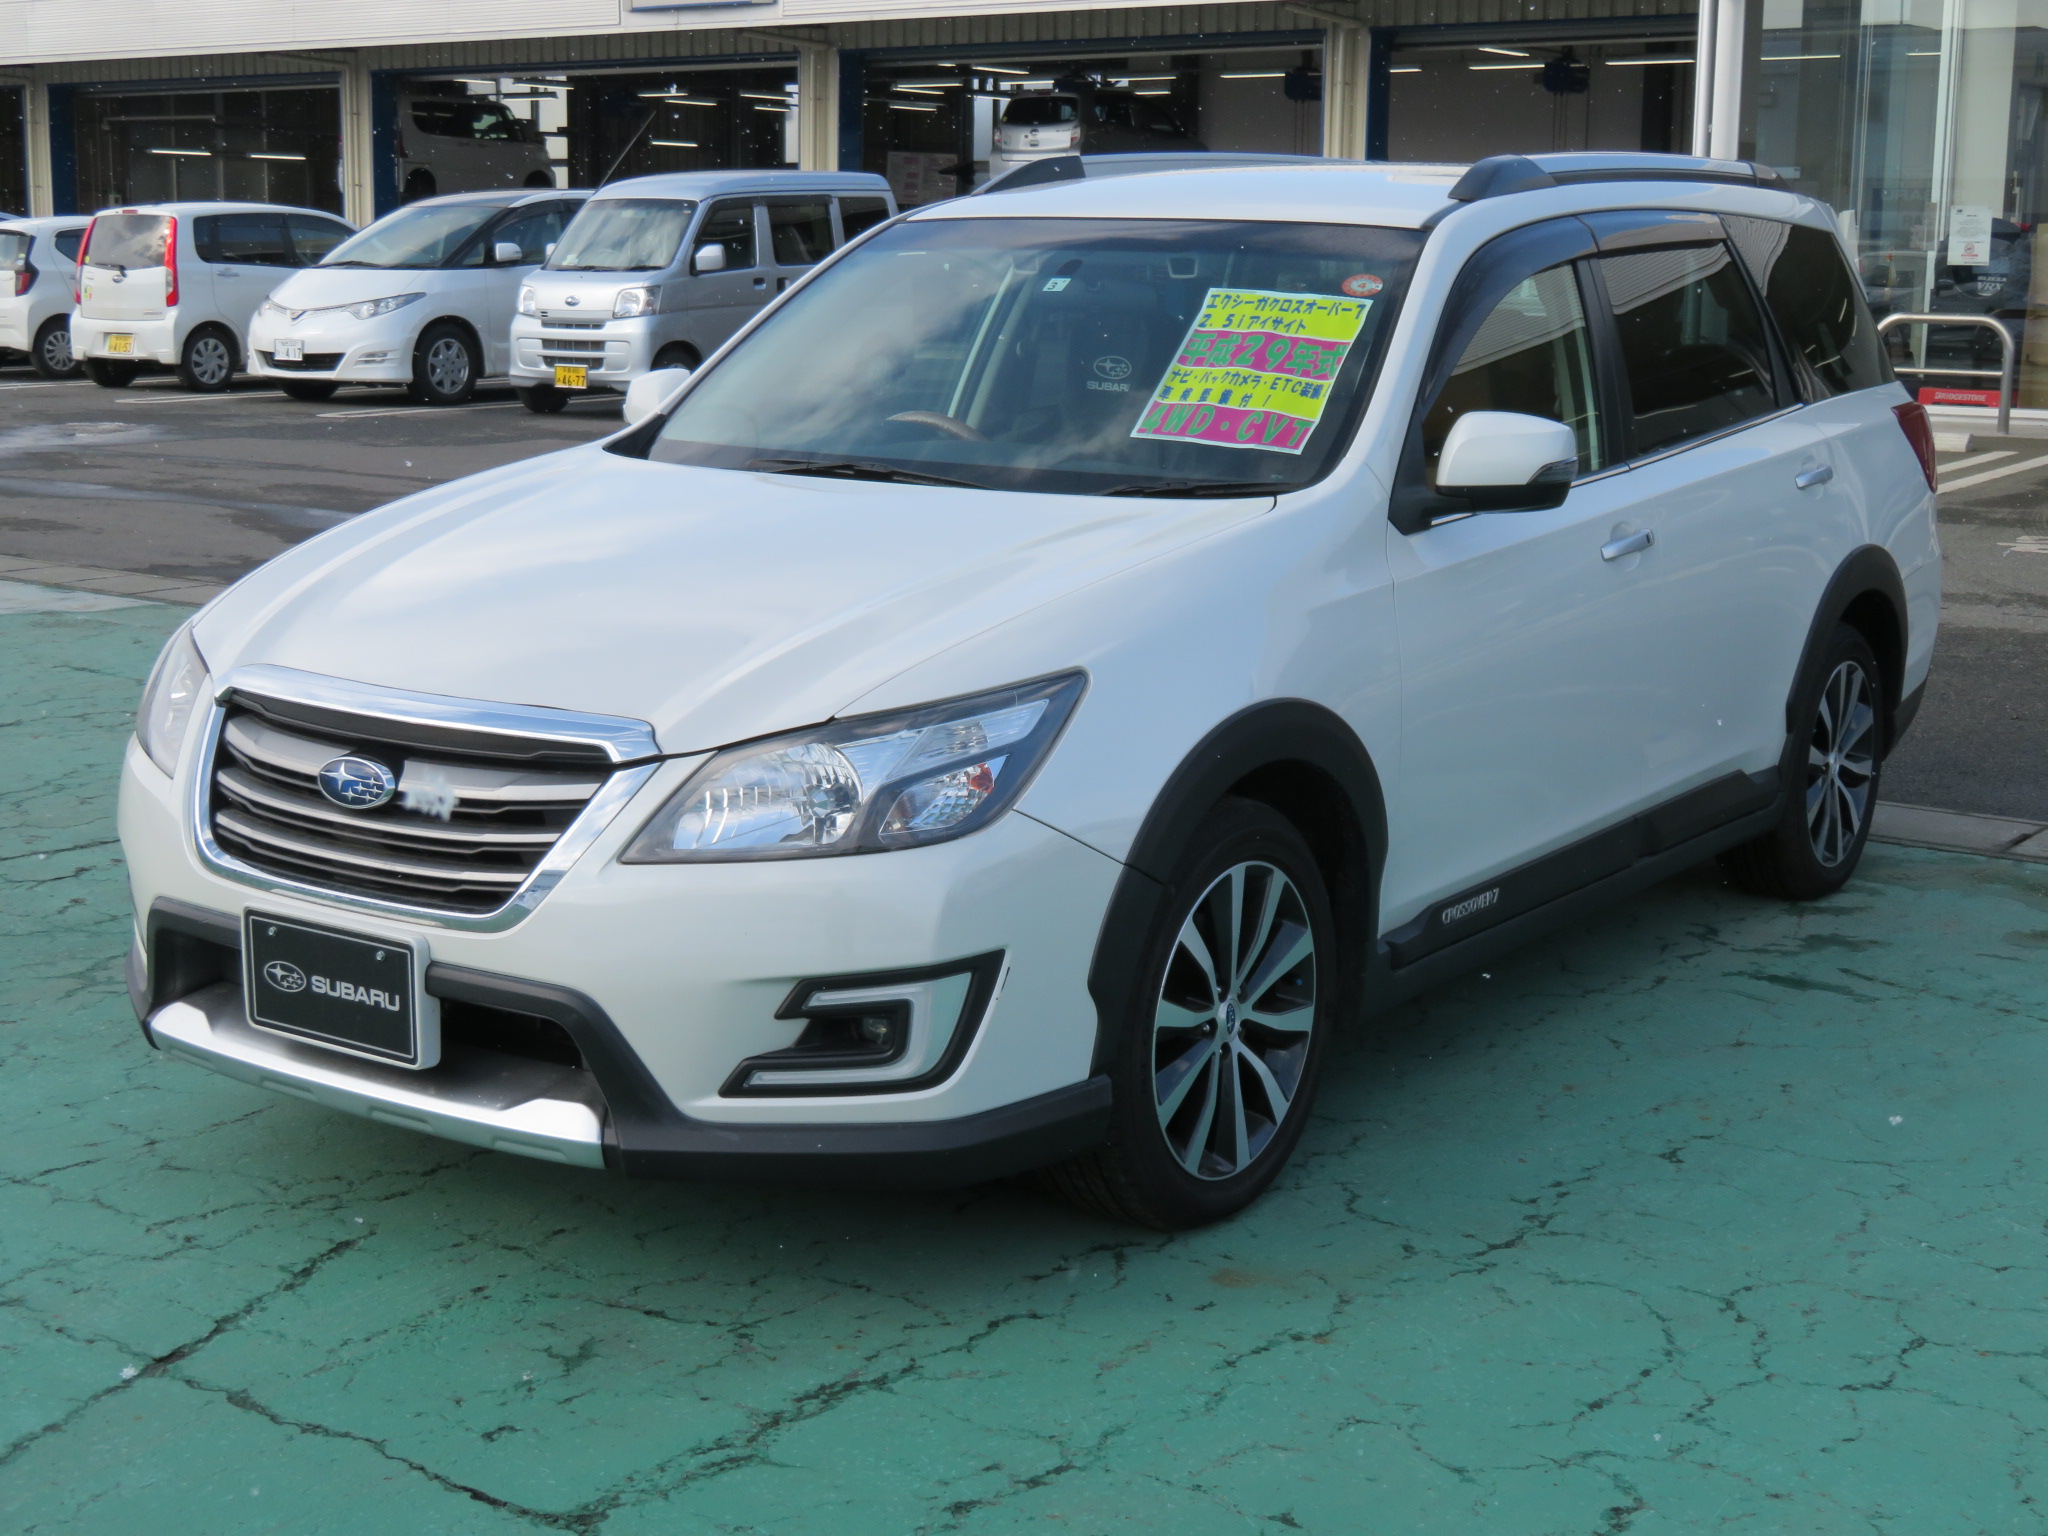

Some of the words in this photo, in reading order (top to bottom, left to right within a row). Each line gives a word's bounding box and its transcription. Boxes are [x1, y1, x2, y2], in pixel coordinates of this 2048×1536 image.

[1179, 332, 1350, 379] 平成29年式
[1934, 391, 1988, 402] BRIDGESTONE
[310, 974, 401, 1012] SUBARU
